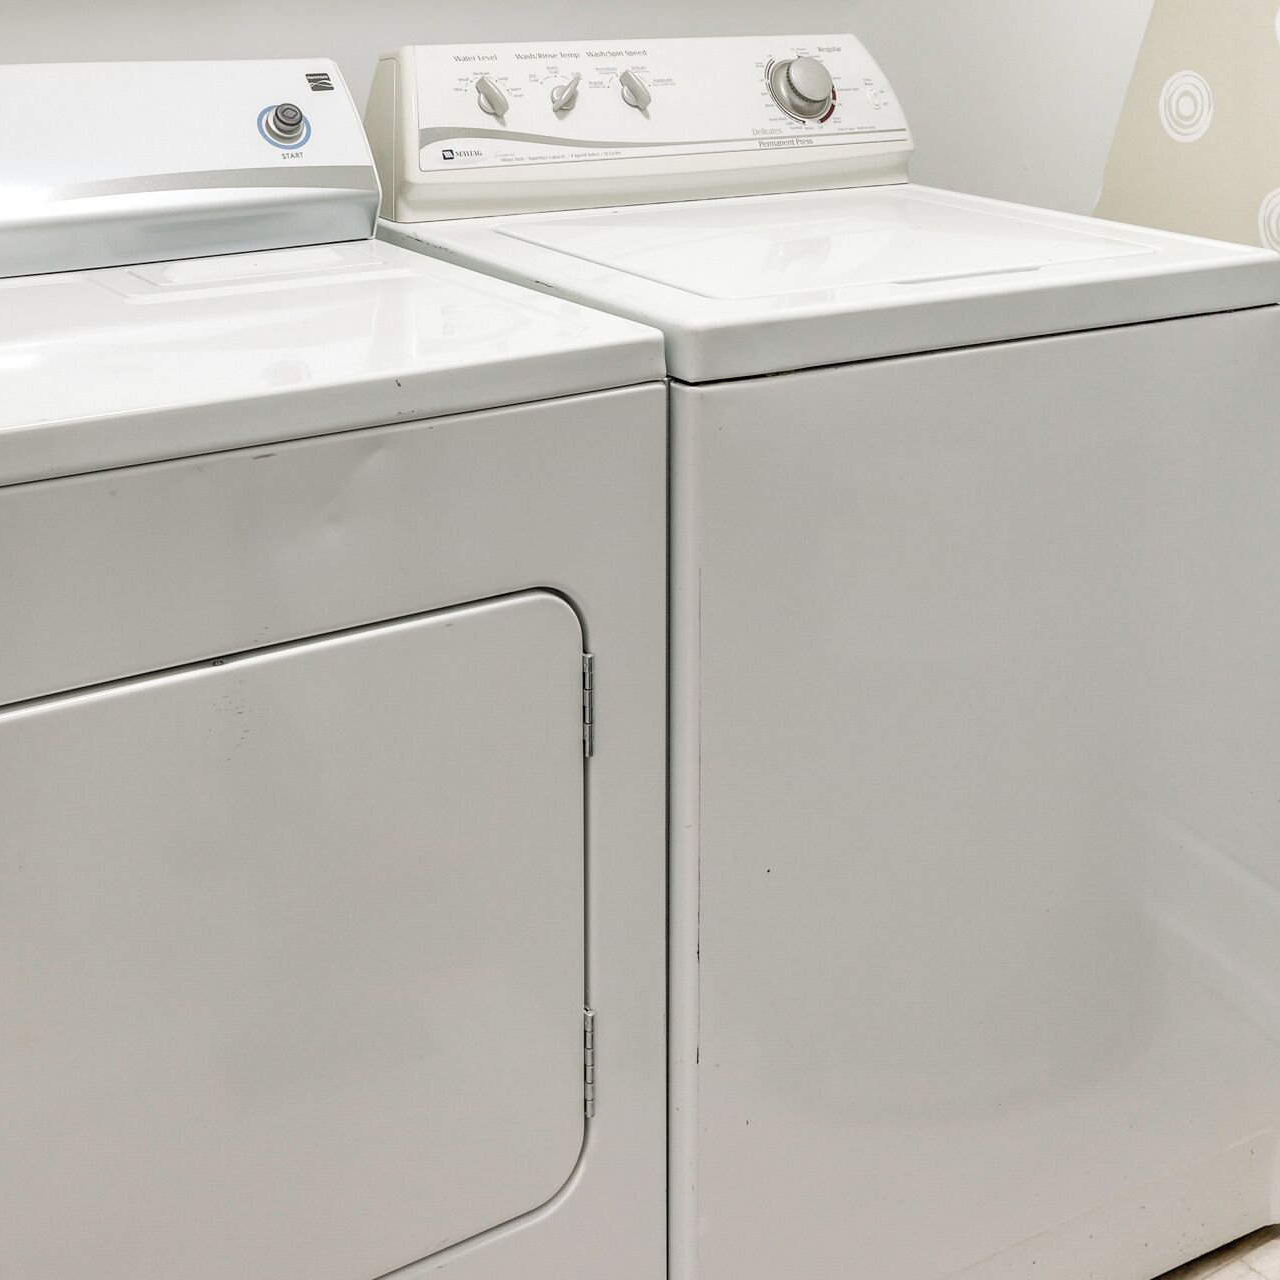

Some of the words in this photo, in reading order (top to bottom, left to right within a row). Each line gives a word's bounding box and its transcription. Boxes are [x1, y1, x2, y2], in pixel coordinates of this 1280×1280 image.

[515, 52, 558, 60] Wash/Rinse
[559, 51, 580, 60] Temp
[585, 50, 623, 58] Wash/Spin
[624, 49, 647, 57] Speed
[752, 127, 783, 136] Delicates
[758, 138, 795, 148] Permanent
[796, 137, 814, 146] Press
[281, 152, 304, 160] START
